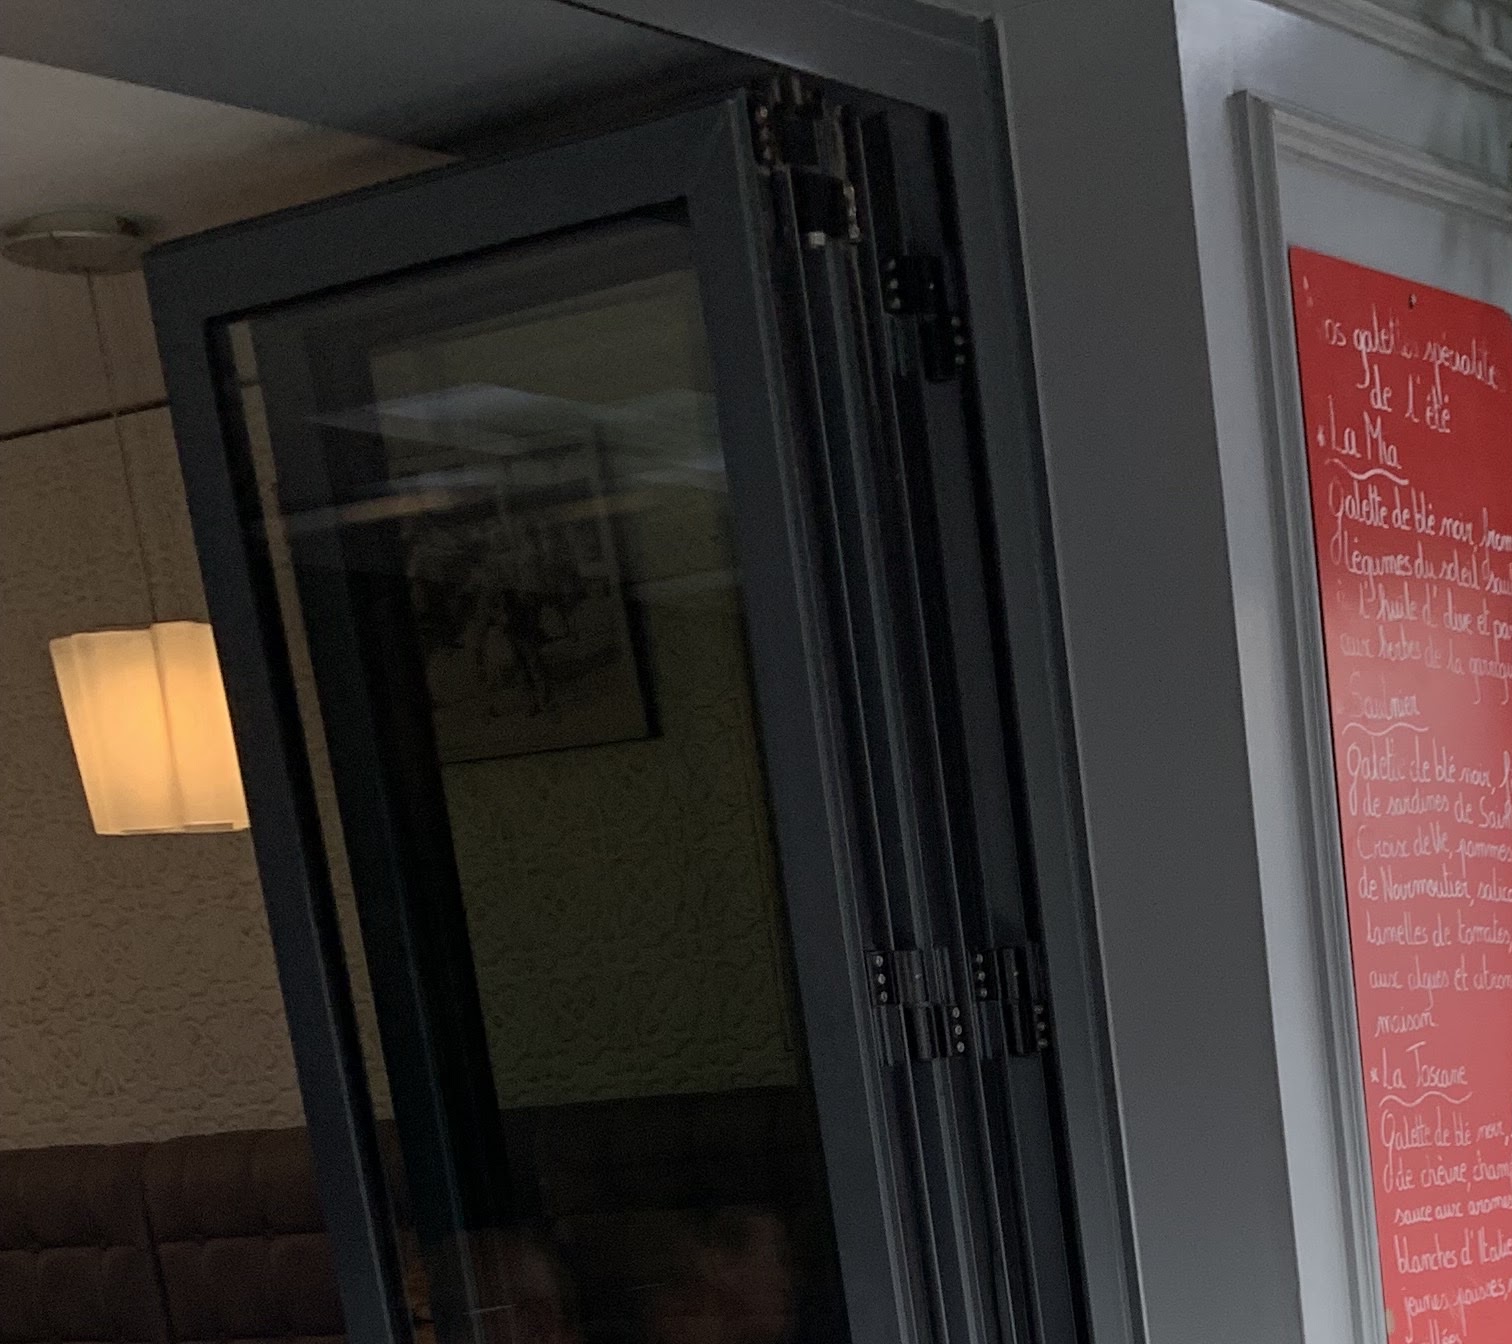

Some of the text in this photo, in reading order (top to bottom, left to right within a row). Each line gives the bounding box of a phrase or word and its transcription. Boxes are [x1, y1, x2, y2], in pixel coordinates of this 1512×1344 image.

[1370, 363, 1393, 412] de
[1328, 394, 1362, 459] La
[1392, 485, 1412, 531] de
[1414, 540, 1438, 580] du
[1409, 735, 1432, 783] de
[1432, 736, 1457, 783] blé
[1363, 782, 1382, 818] de
[1455, 792, 1474, 825] de
[1358, 867, 1380, 902] de
[1432, 913, 1452, 948] de
[1369, 968, 1404, 991] aux
[1453, 953, 1469, 992] et
[1406, 1041, 1469, 1089] Toscane
[1434, 1105, 1453, 1147] de
[1453, 1110, 1473, 1147] blé
[1395, 1156, 1416, 1191] de
[1435, 1202, 1464, 1220] aux
